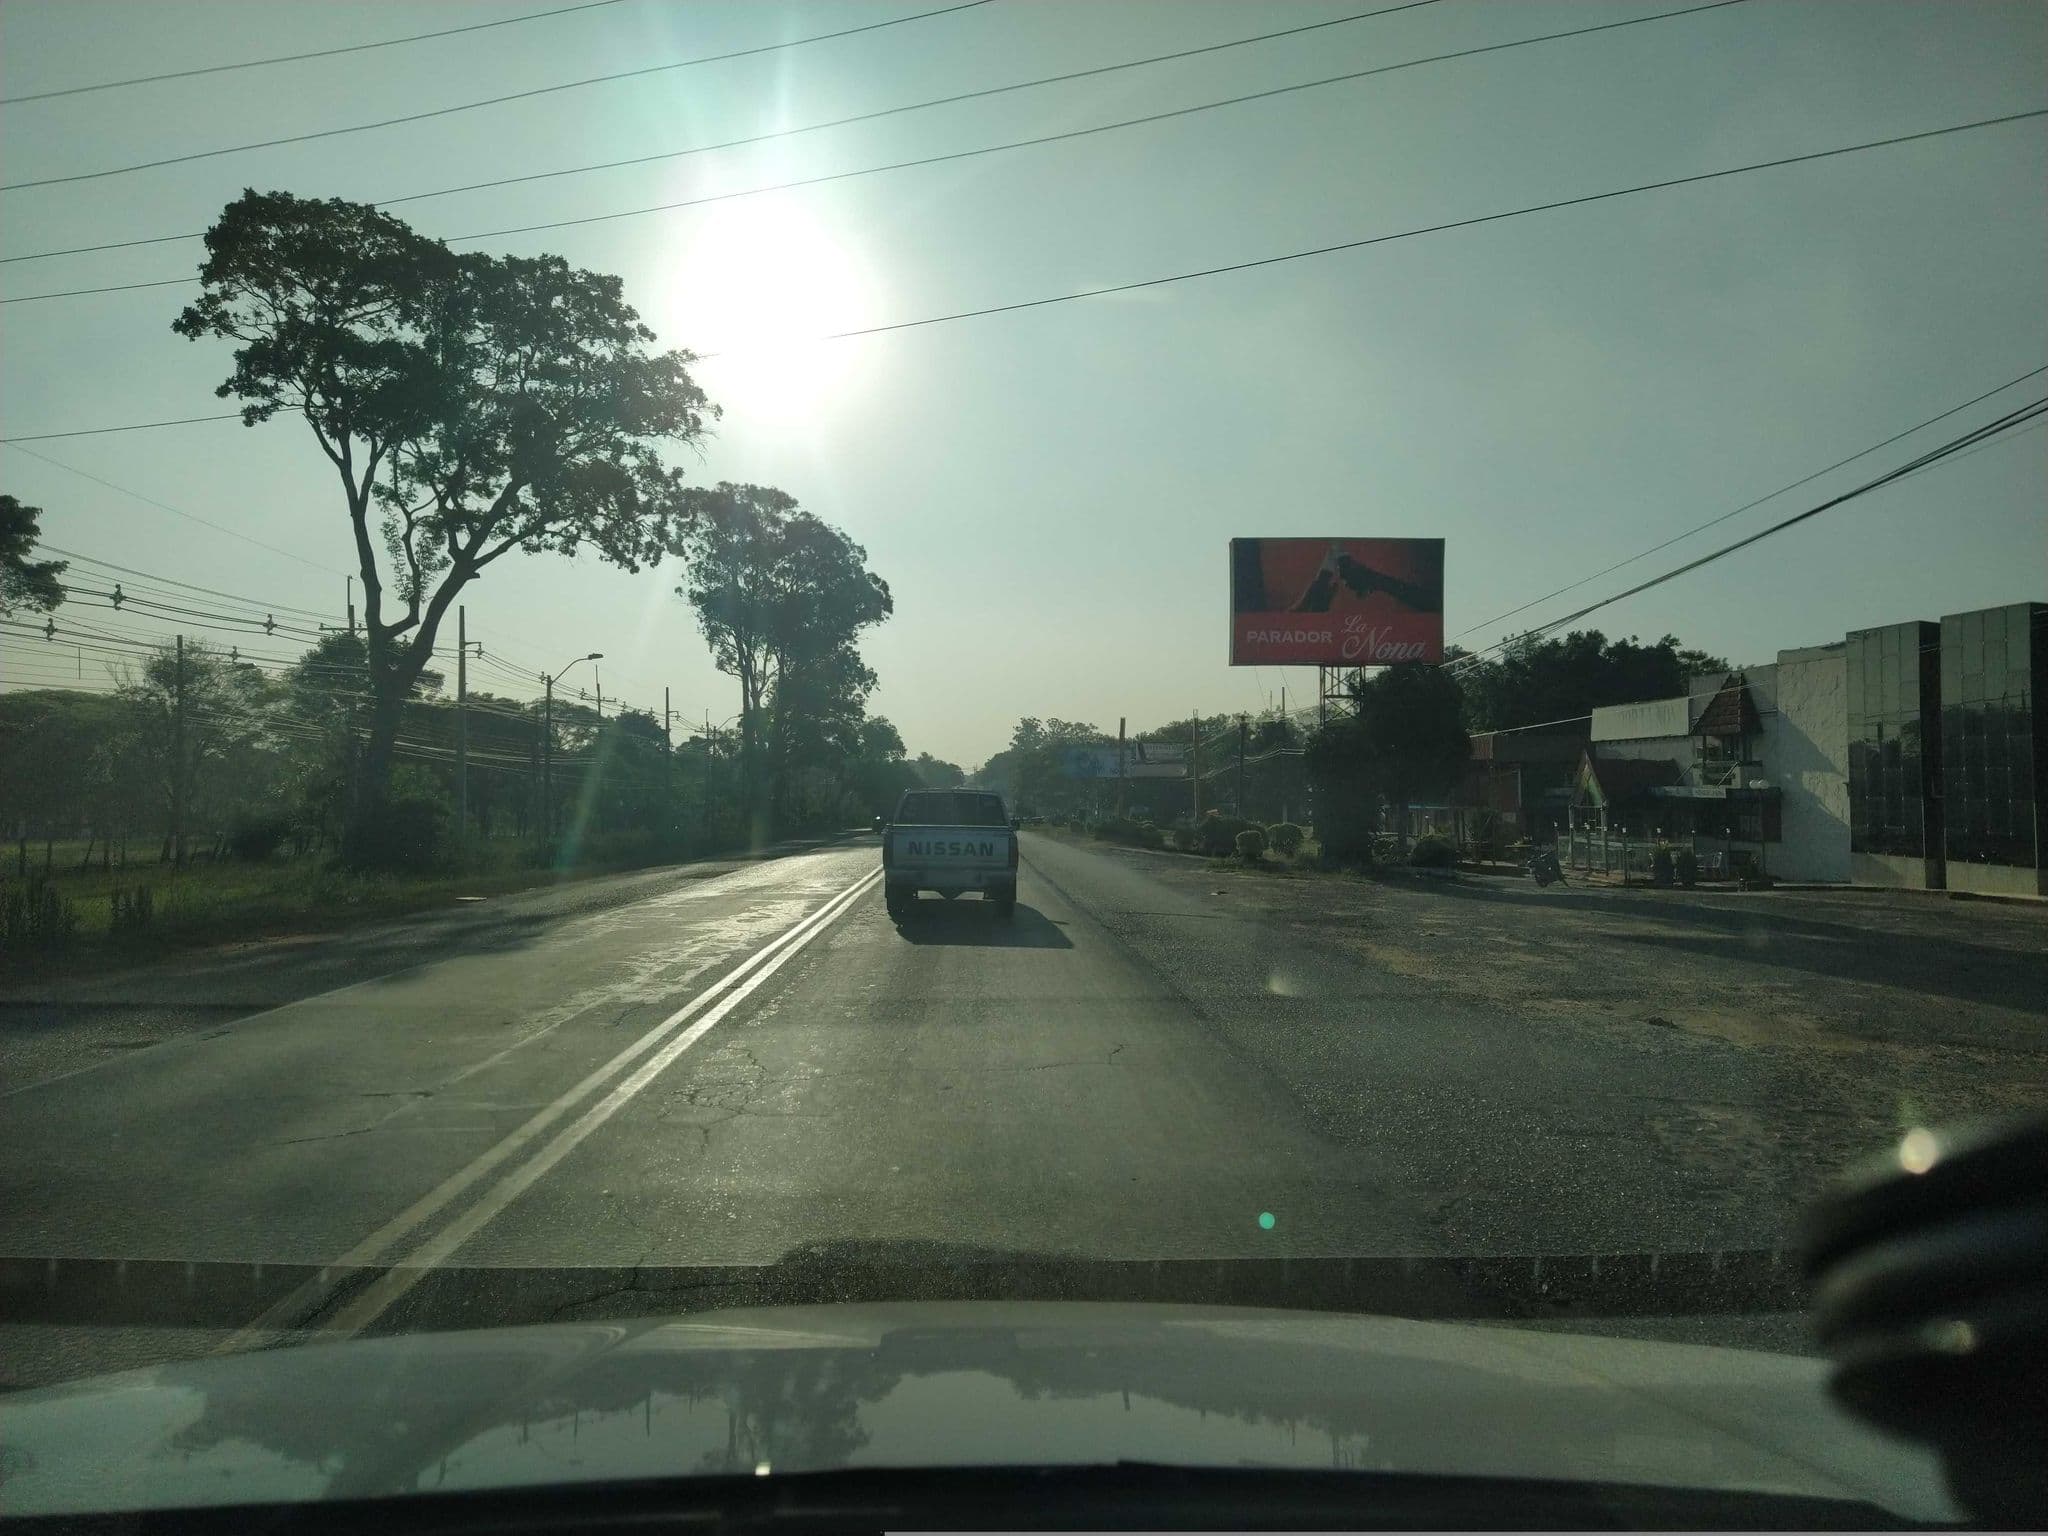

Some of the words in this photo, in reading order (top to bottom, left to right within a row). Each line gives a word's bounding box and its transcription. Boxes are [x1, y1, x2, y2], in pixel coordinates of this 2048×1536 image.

[1341, 615, 1368, 633] La
[1246, 631, 1333, 643] PARADOR
[1341, 625, 1427, 660] Nona
[908, 841, 994, 857] NISSAN
